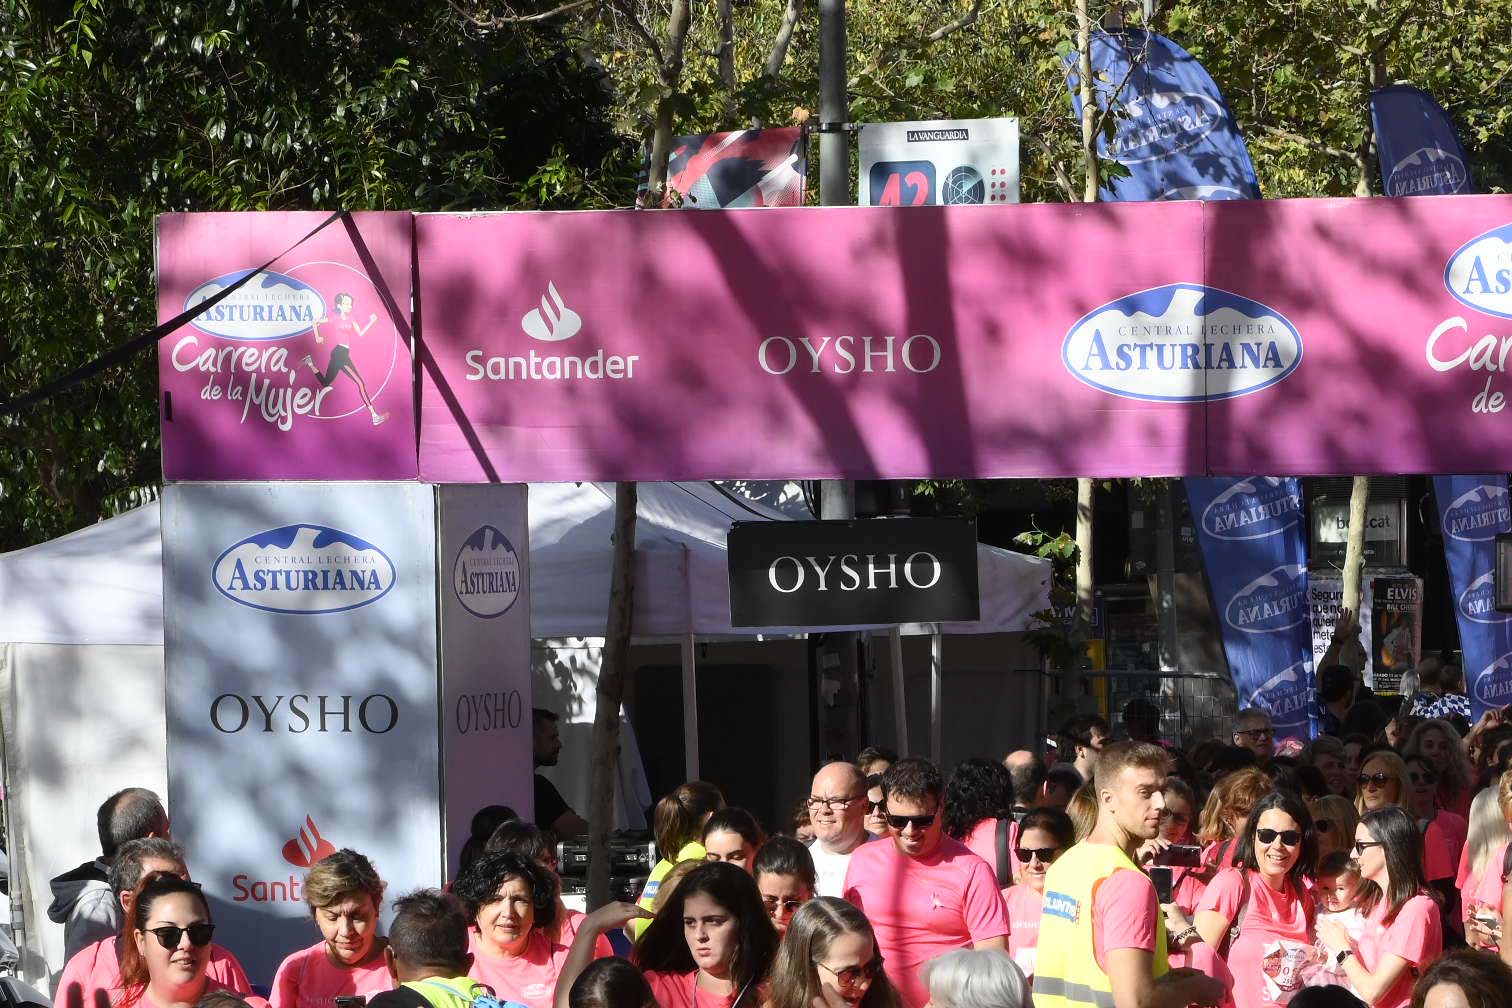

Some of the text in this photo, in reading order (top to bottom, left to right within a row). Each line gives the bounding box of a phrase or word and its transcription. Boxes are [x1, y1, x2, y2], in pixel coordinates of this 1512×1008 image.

[1118, 324, 1276, 336] CENTRAL LECHERA
[172, 336, 288, 372] Carrera
[465, 349, 640, 381] Santander
[758, 334, 941, 375] OYSHO
[1082, 329, 1284, 371] ASTURIANA
[201, 371, 333, 431] de la Mujer
[1472, 377, 1504, 414] de
[1337, 517, 1391, 531] b.cat
[227, 558, 383, 591] ASTURIANA
[254, 555, 375, 564] CENTRAL LECHERA
[768, 551, 941, 593] OYSHO
[459, 561, 516, 595] ASTURIANA
[1387, 588, 1417, 600] ELVIS
[1312, 618, 1335, 629] quier
[210, 694, 399, 734] OYSHO
[457, 690, 521, 735] OYSHO
